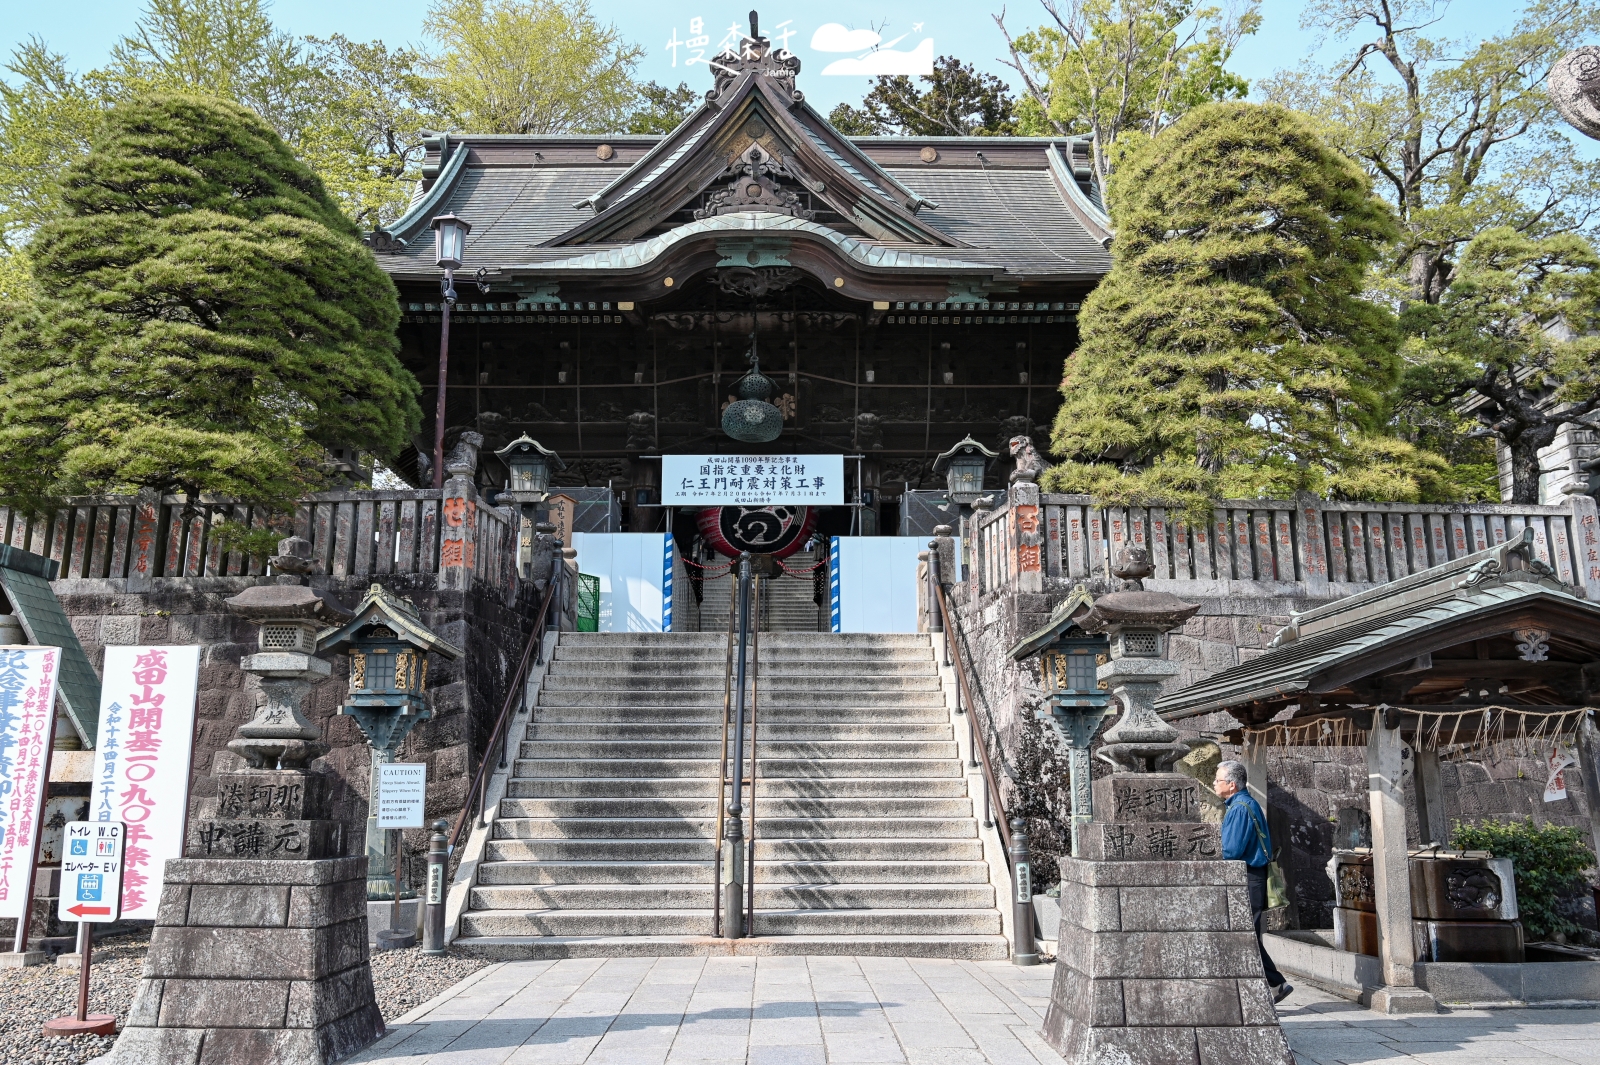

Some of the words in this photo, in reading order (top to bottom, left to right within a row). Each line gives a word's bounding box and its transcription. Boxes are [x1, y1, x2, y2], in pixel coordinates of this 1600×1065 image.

[700, 464, 806, 476] 国指定重要文化財
[681, 476, 825, 490] 仁王門耐震対策工事
[70, 826, 91, 836] トイレ
[64, 862, 99, 872] エレベーター
[103, 862, 117, 872] EV
